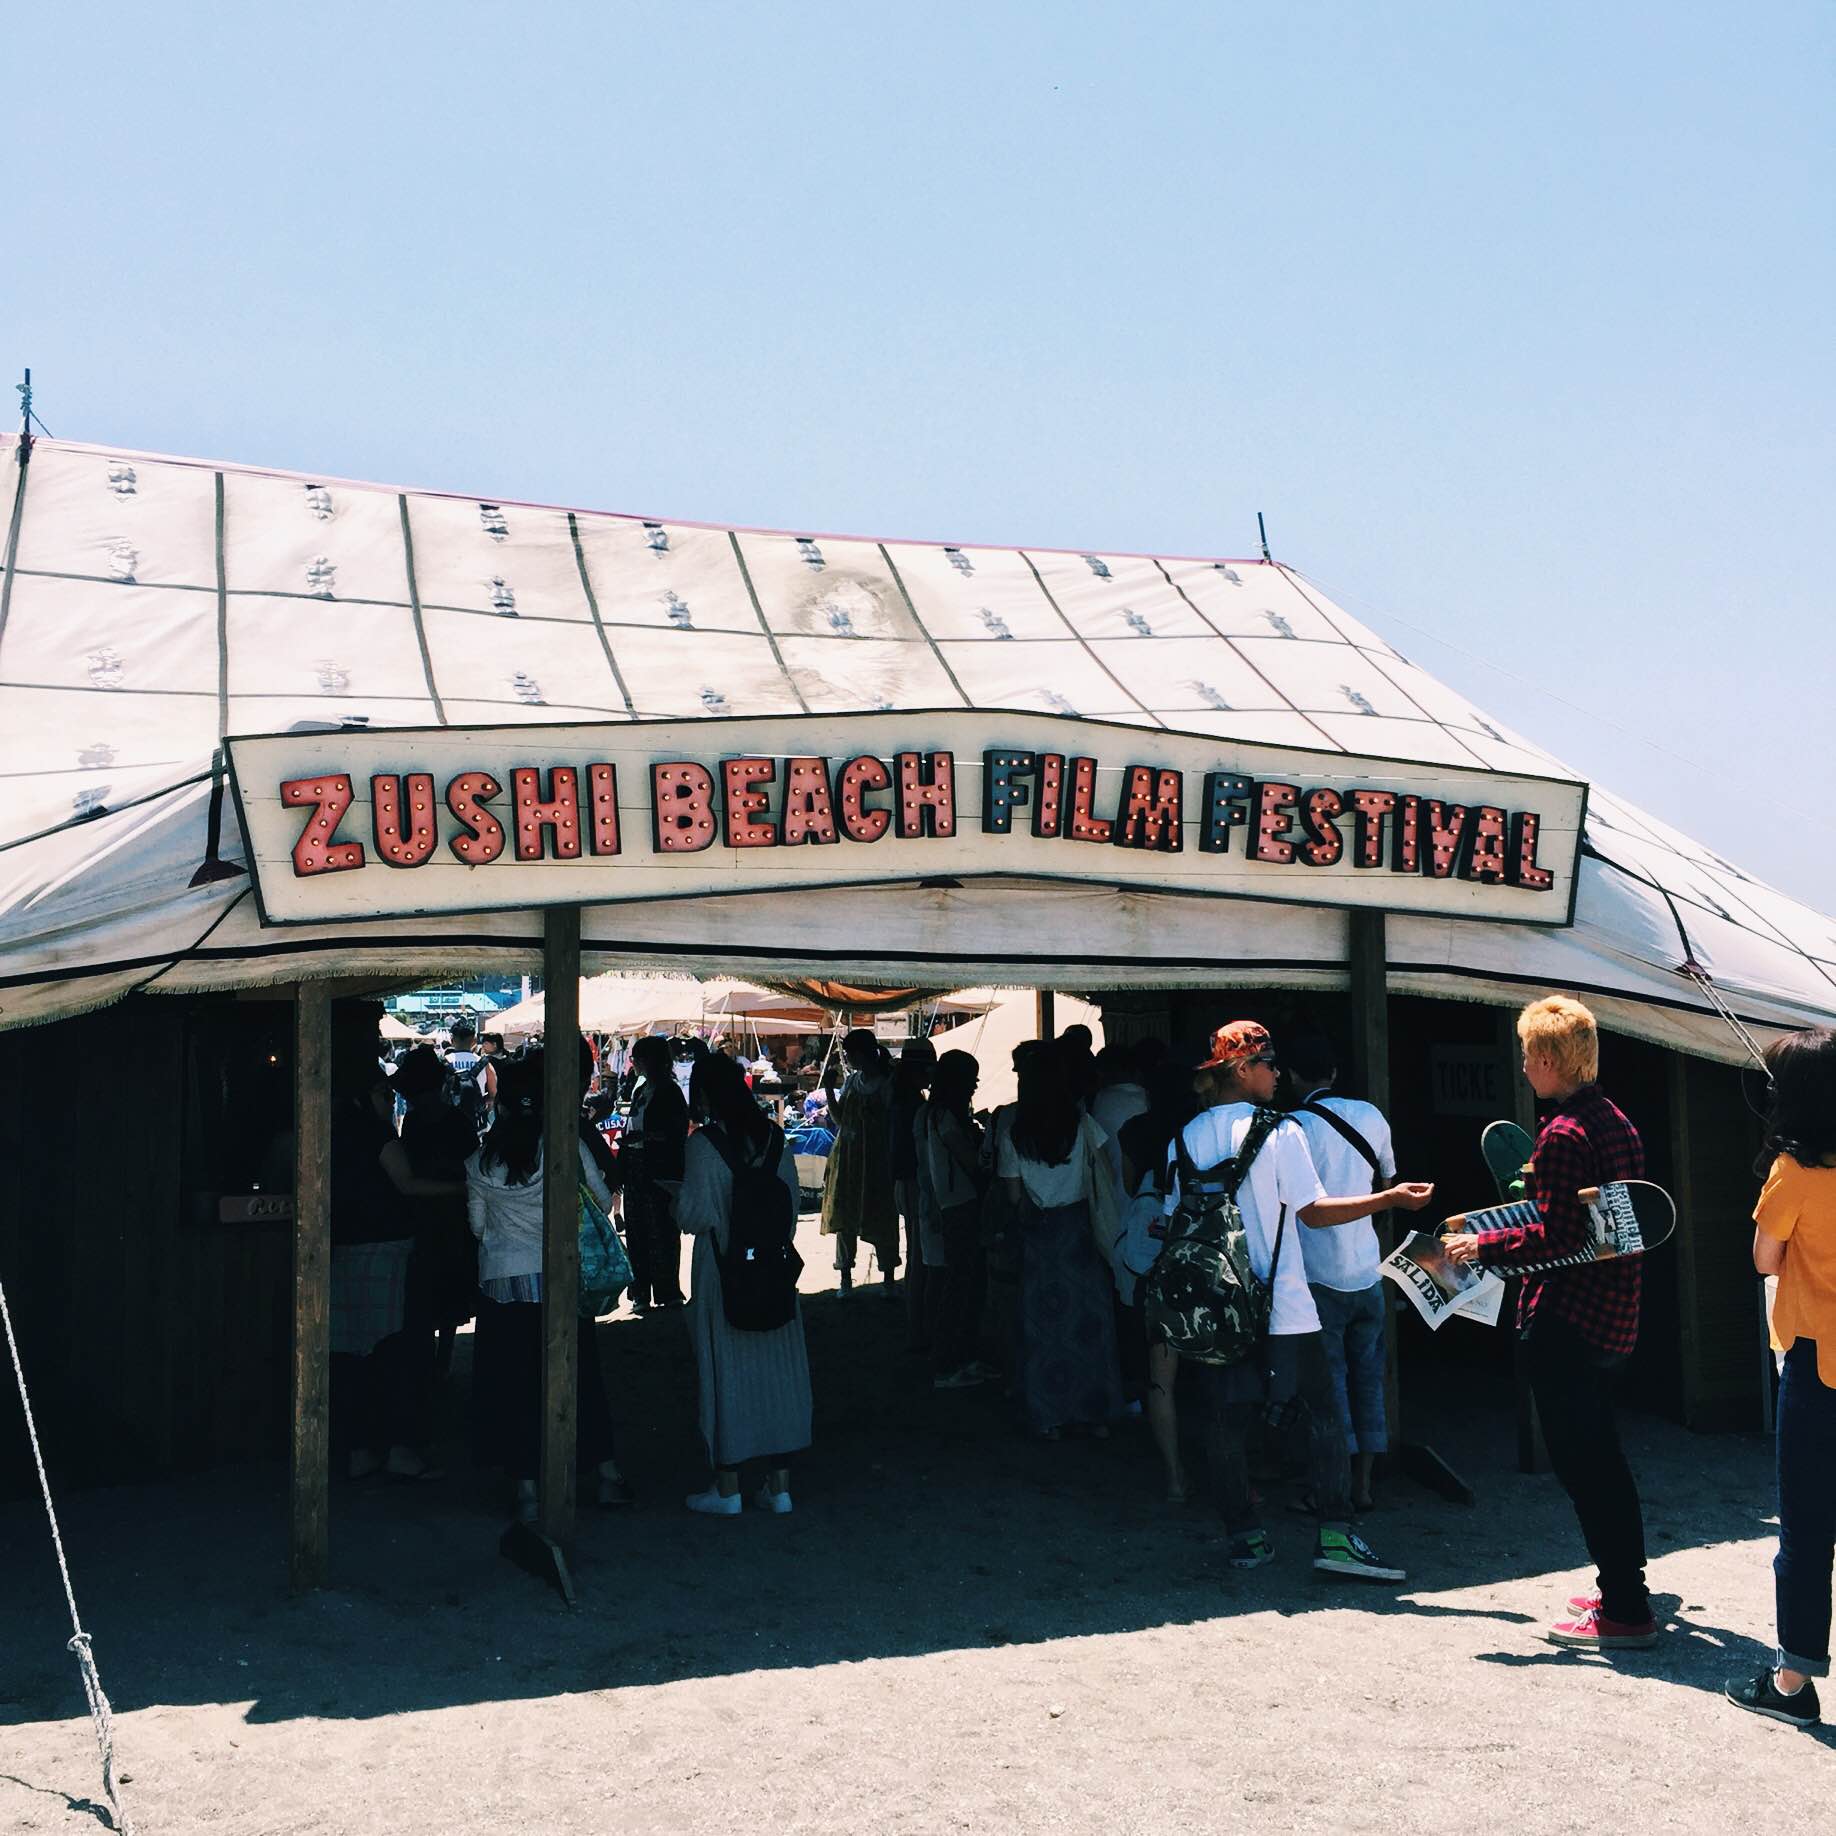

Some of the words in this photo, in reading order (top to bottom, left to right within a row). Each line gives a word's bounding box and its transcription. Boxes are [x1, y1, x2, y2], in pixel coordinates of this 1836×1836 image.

[279, 762, 624, 878] ZUSHI
[650, 751, 956, 854] BEACH
[982, 749, 1185, 854] FILM
[1198, 770, 1556, 891] FESTIVAL
